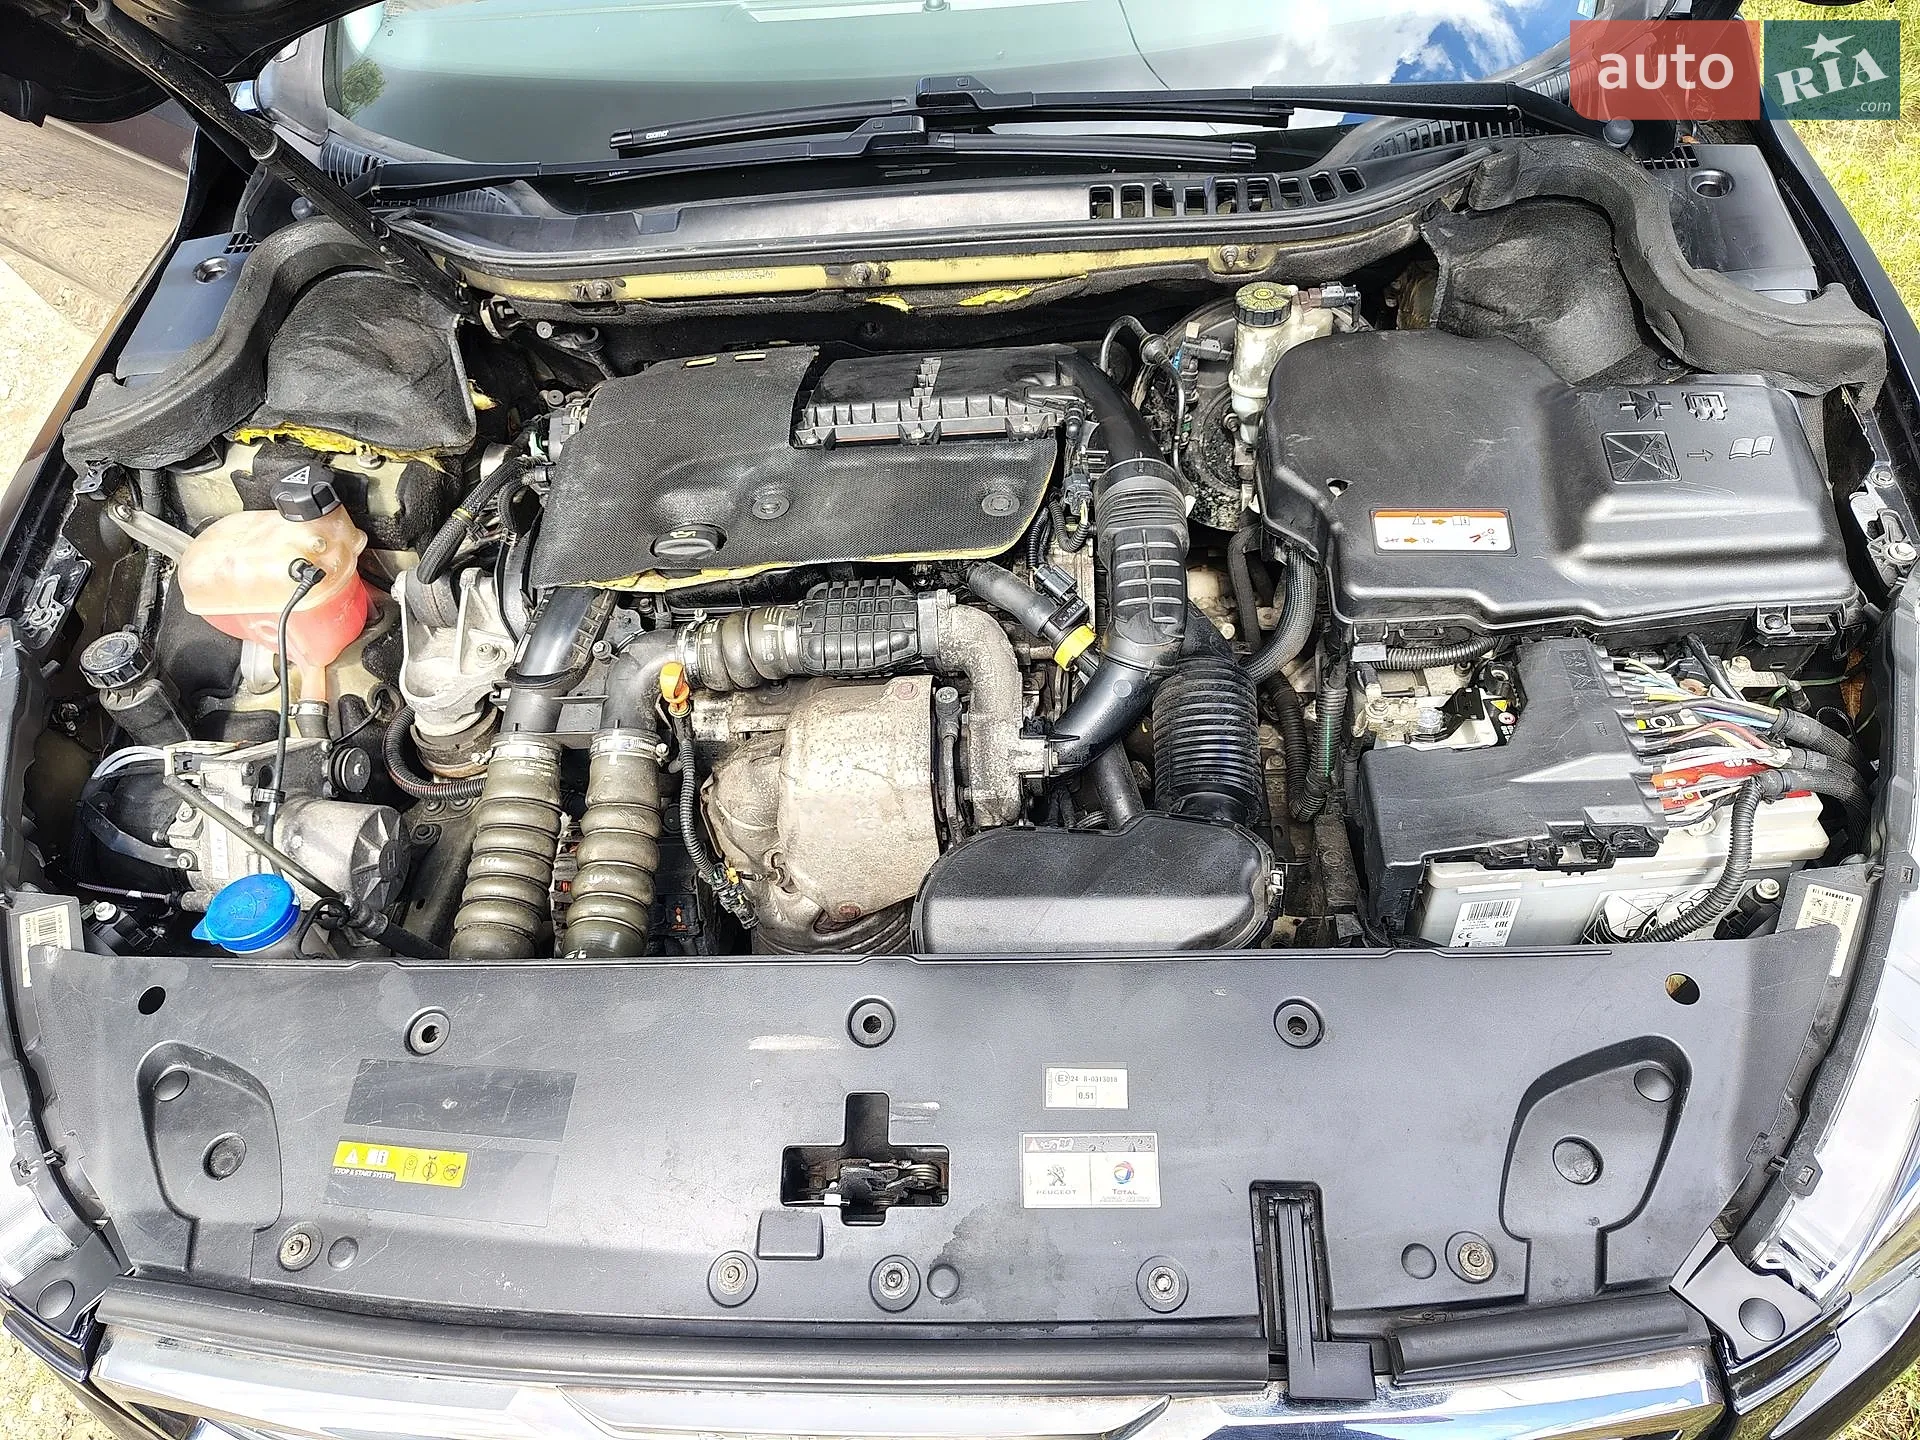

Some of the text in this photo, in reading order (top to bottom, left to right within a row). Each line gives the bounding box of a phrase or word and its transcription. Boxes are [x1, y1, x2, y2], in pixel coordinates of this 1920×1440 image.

[1078, 1091, 1094, 1100] 0.51
[355, 1169, 371, 1178] START
[371, 1171, 395, 1180] SYSTEM
